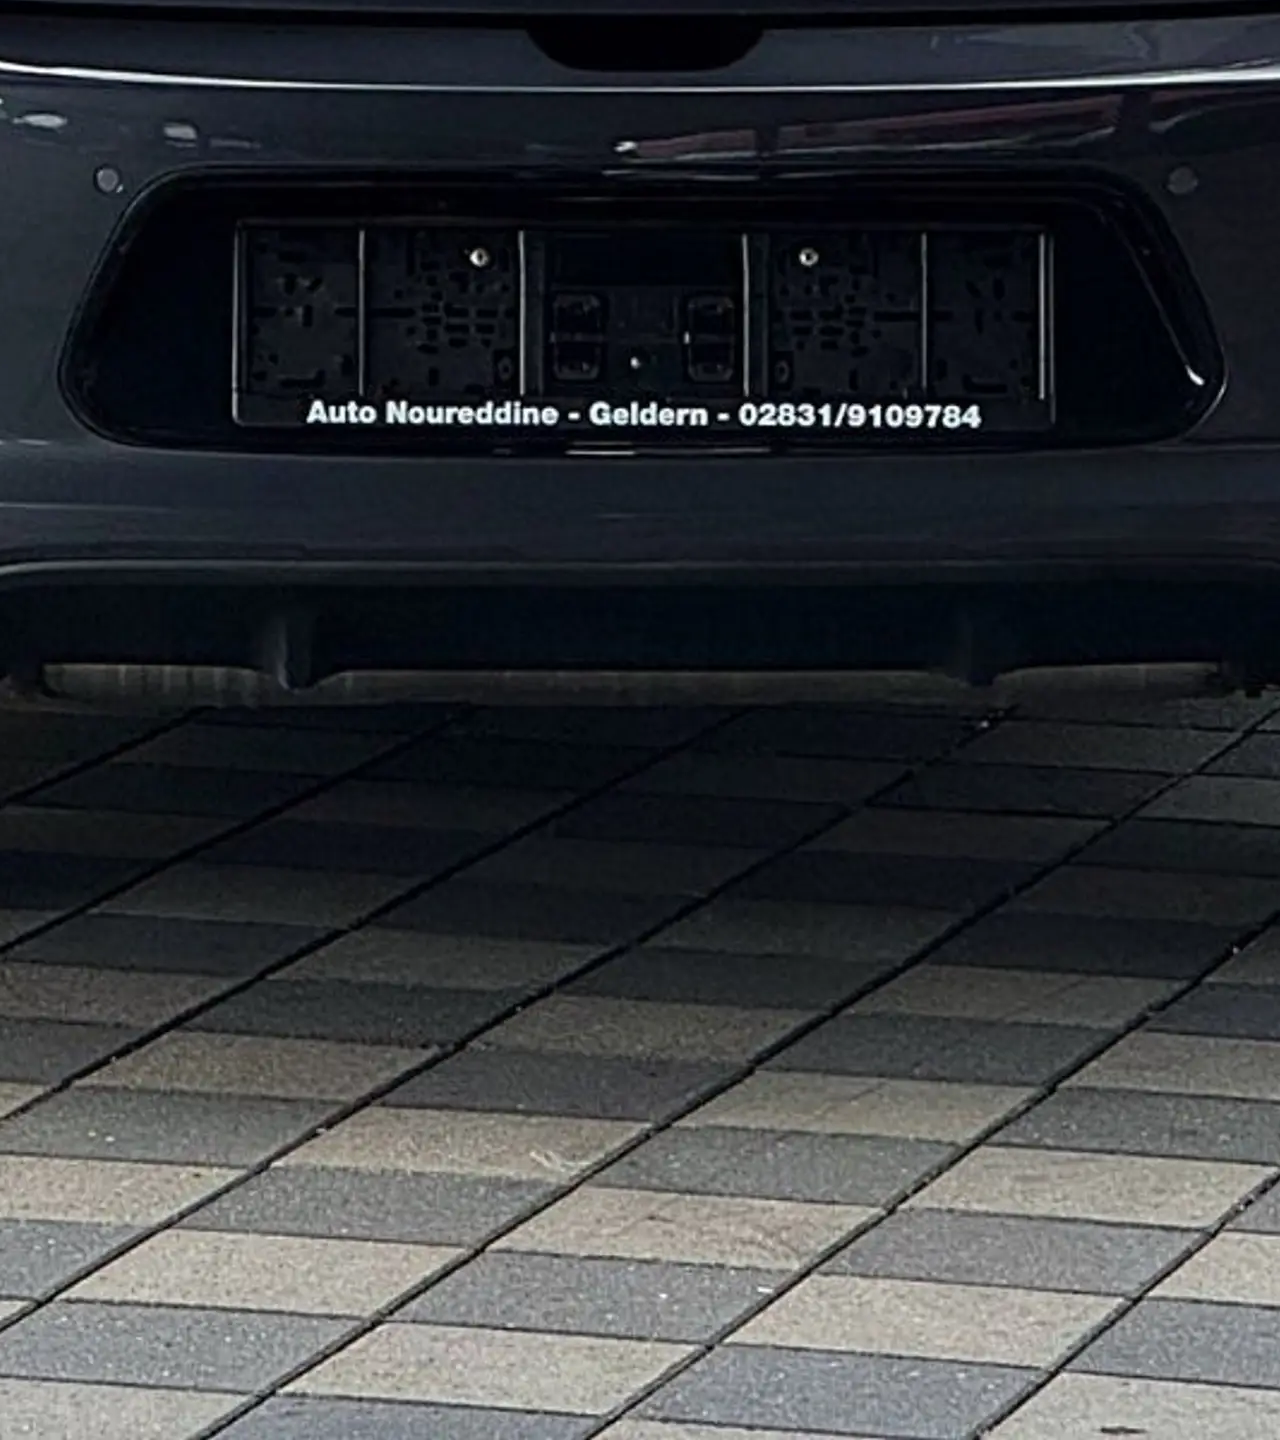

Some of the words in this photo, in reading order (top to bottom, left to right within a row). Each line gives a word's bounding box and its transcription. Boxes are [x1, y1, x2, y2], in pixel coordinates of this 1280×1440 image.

[306, 399, 377, 425] Auto
[385, 399, 559, 426] Noureddine
[588, 400, 709, 426] Geldern
[737, 402, 983, 429] 02831/9109784
